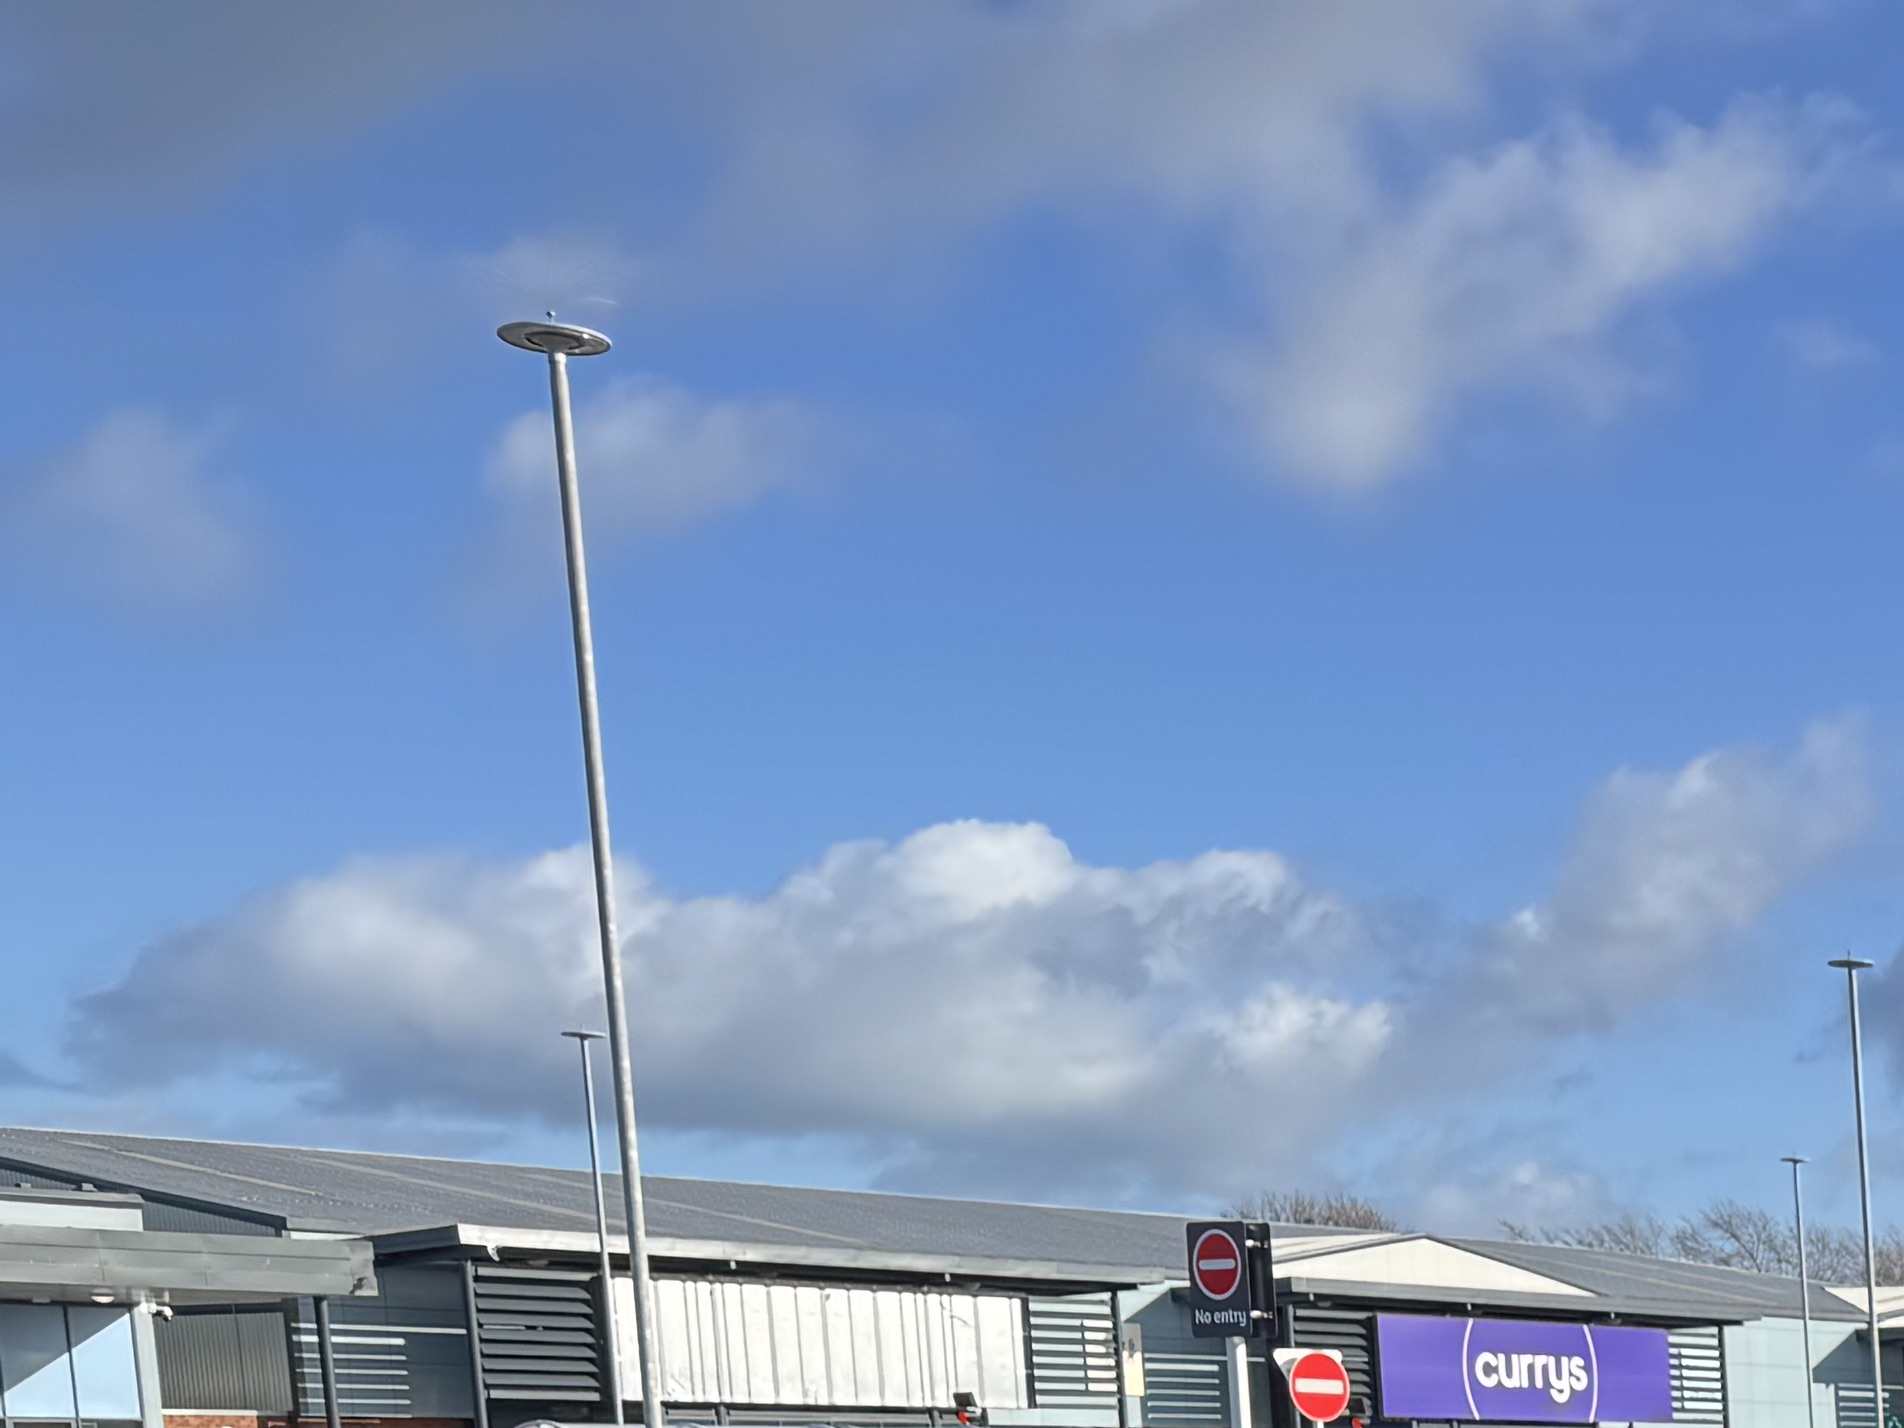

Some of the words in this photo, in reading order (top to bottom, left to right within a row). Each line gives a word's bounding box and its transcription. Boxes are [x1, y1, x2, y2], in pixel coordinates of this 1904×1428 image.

[1195, 1308, 1212, 1325] No
[1213, 1308, 1247, 1327] entry
[1475, 1351, 1588, 1404] currys
